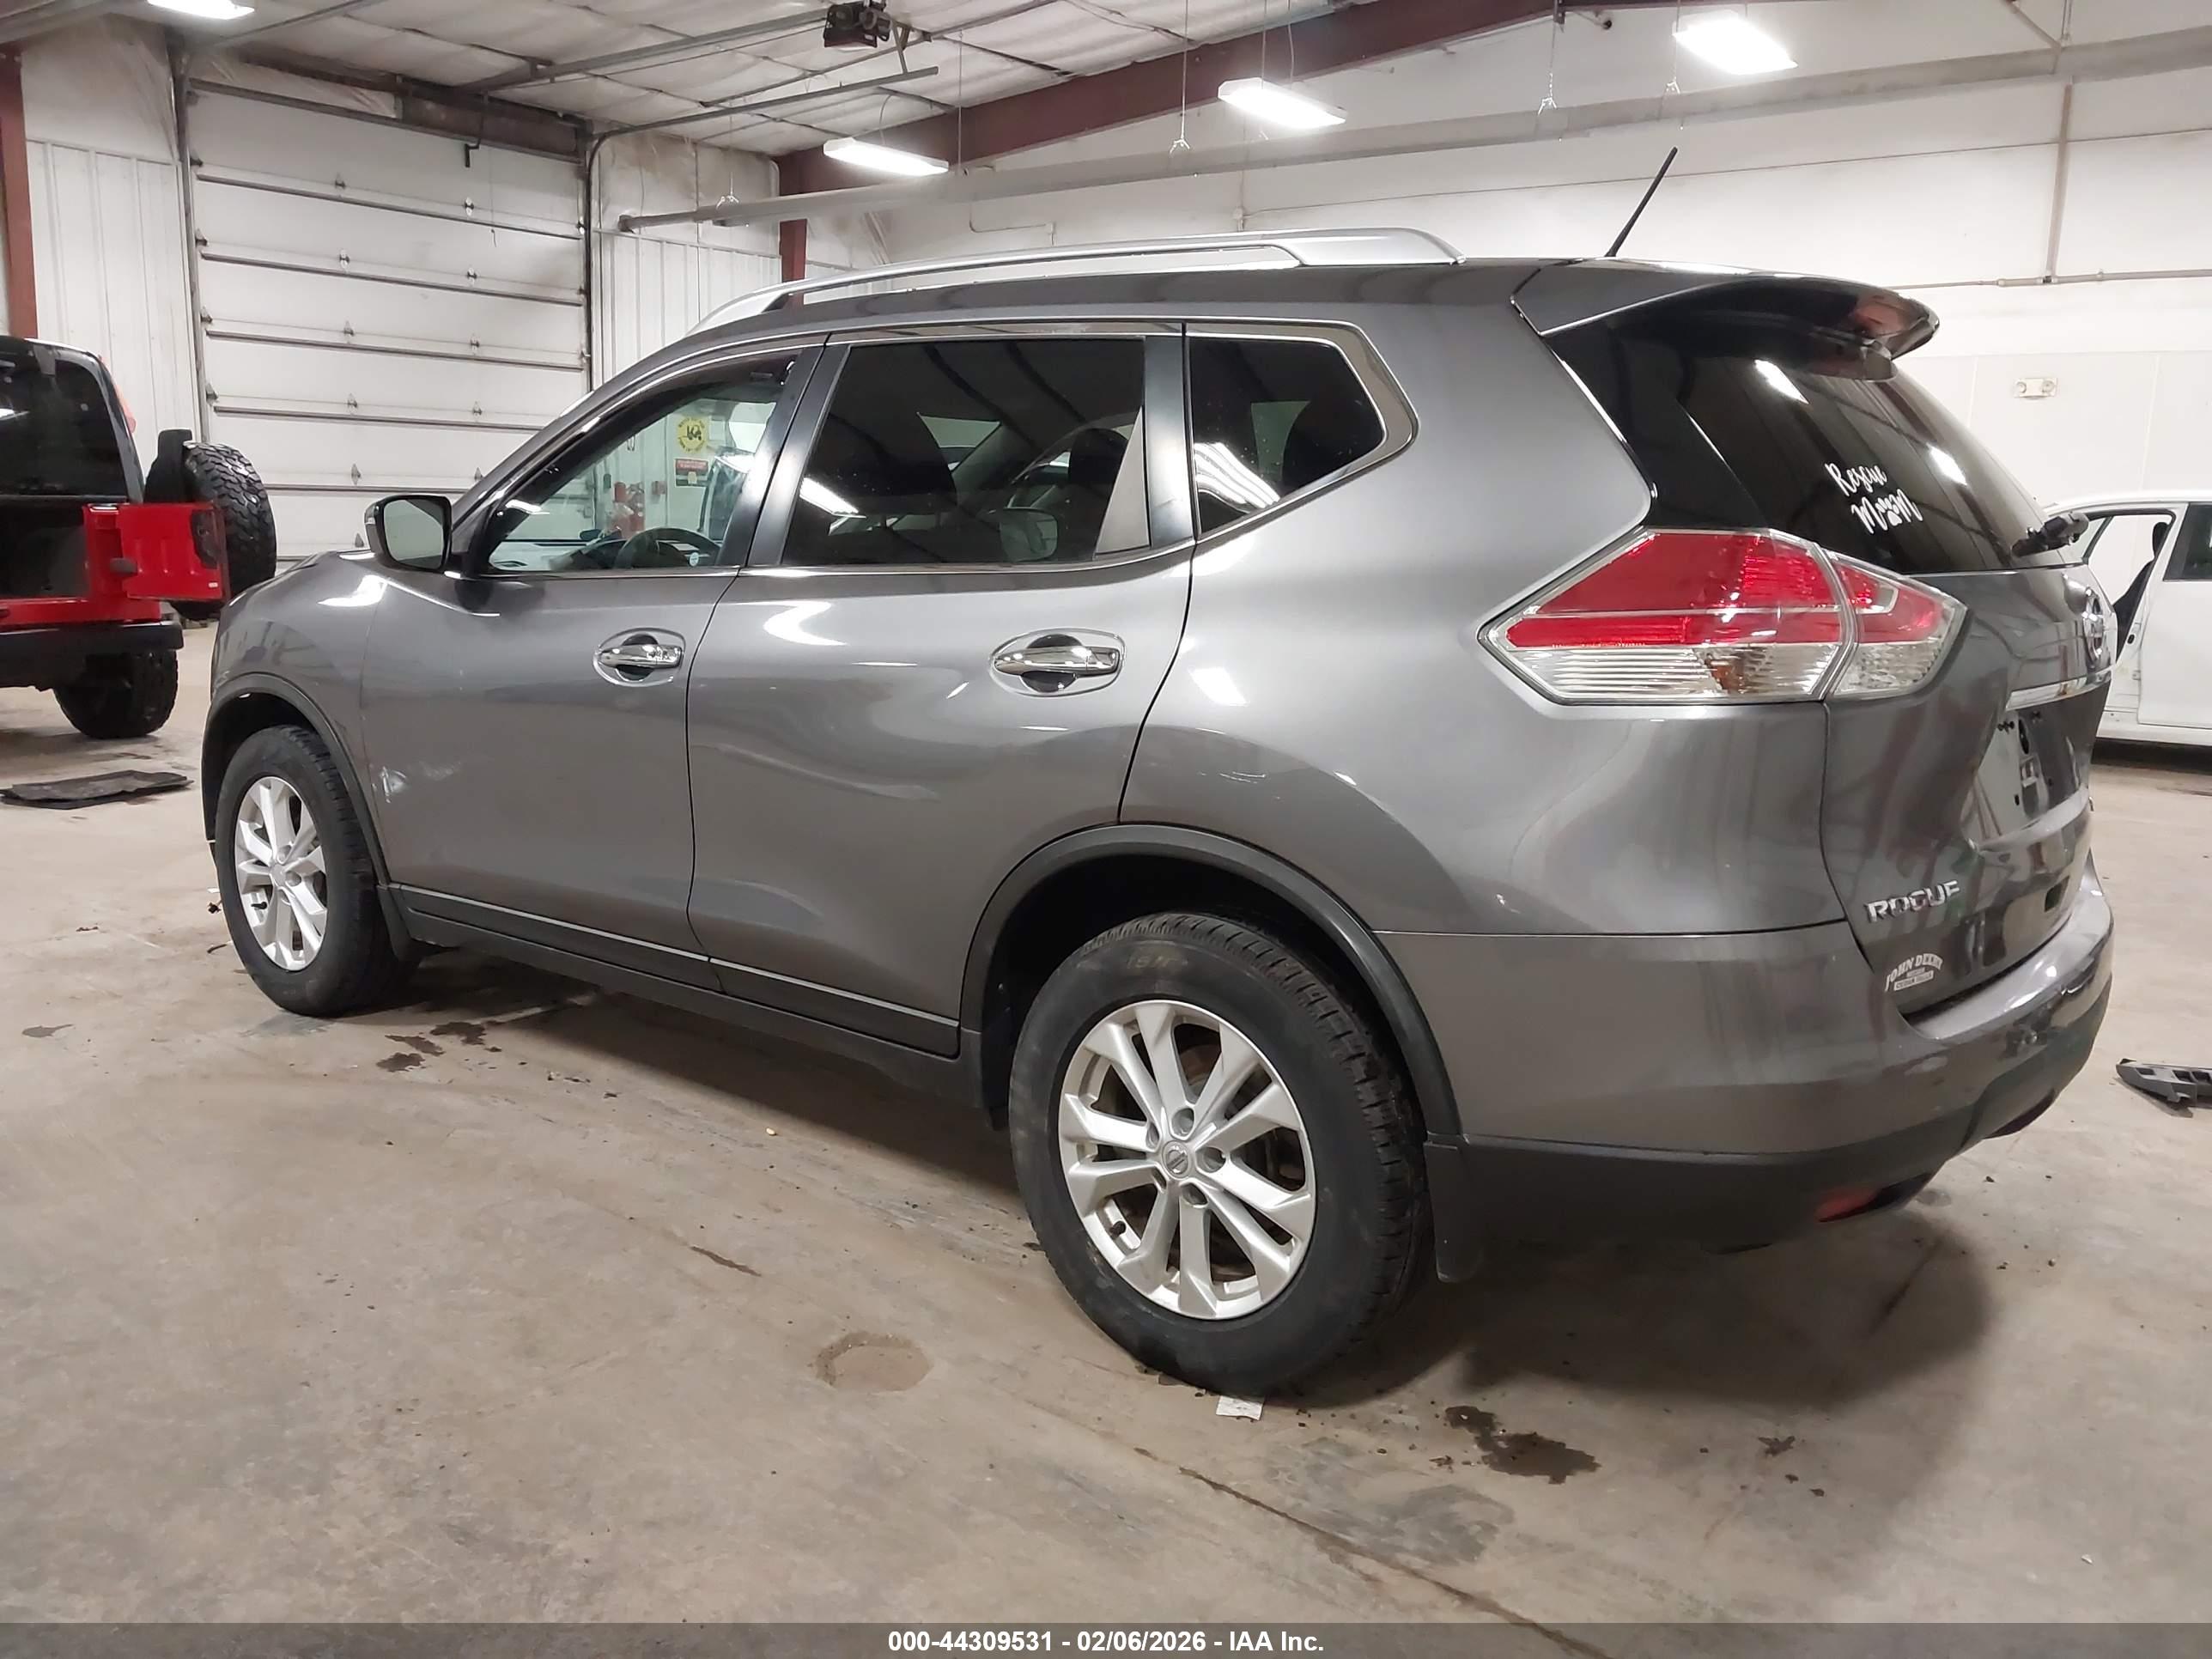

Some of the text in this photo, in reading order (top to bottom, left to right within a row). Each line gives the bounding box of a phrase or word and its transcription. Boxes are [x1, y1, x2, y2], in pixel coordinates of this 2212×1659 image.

[1824, 462, 1888, 496] Rescue
[1867, 879, 1960, 922] ROGUE
[1884, 957, 1915, 993] JOHN
